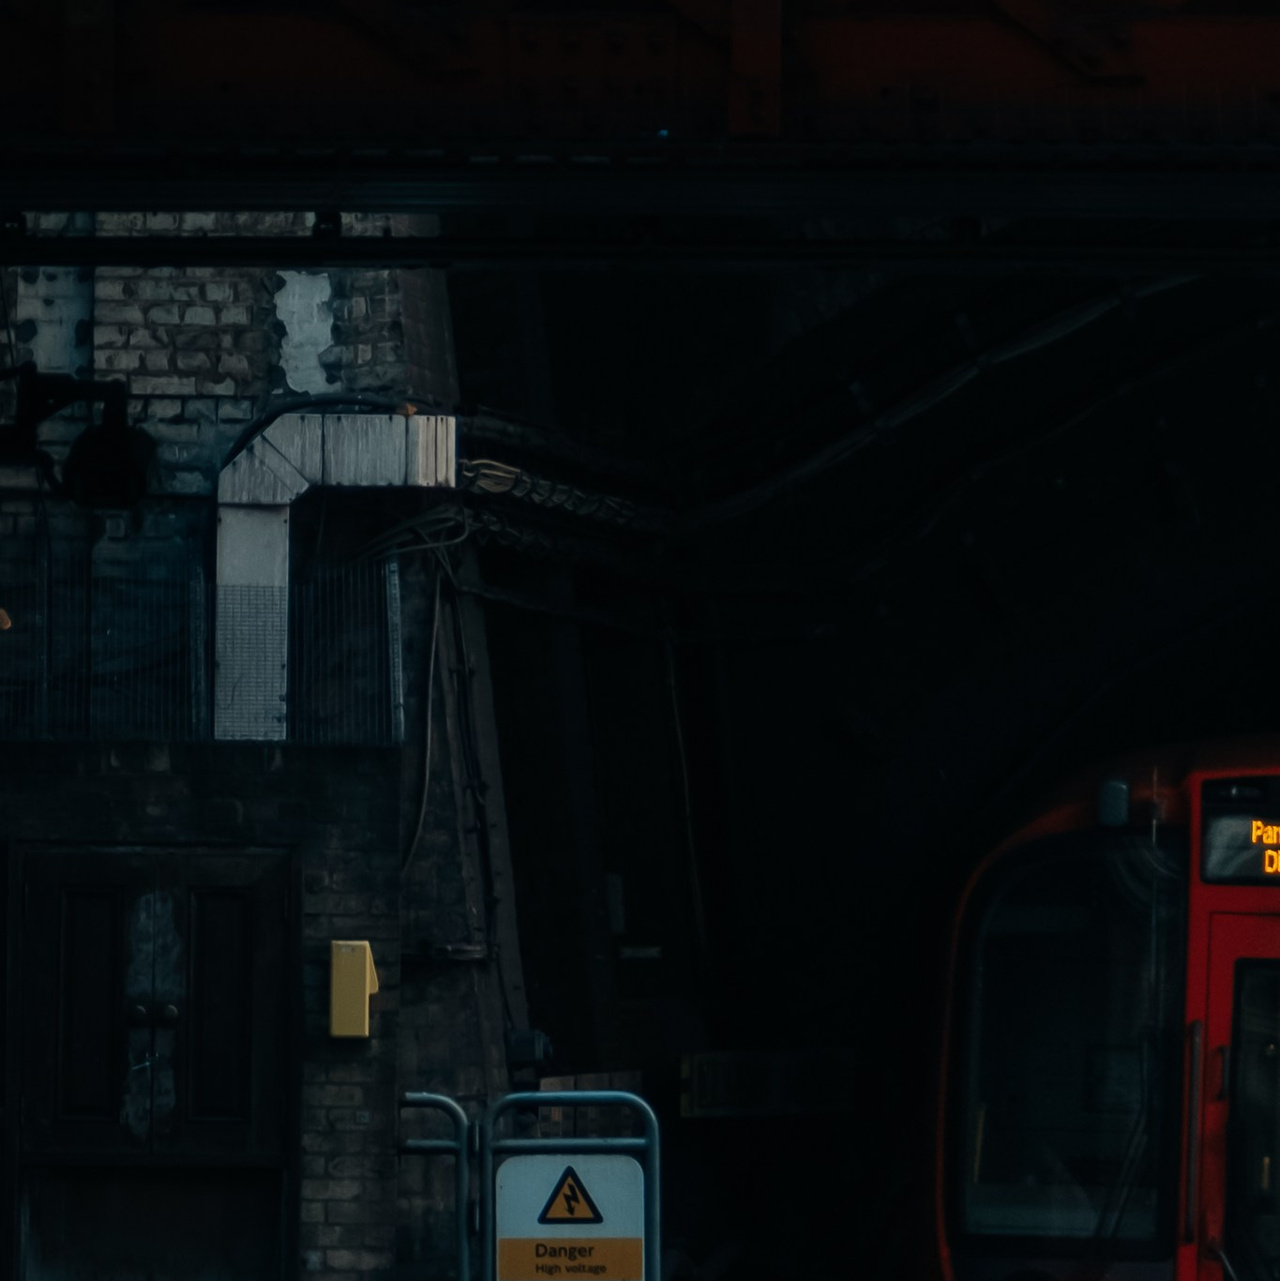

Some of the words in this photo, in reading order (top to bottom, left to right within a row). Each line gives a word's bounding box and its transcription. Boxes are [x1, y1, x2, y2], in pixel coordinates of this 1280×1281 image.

[535, 1243, 595, 1261] Danger
[535, 1263, 561, 1275] High
[565, 1263, 607, 1275] voltage
